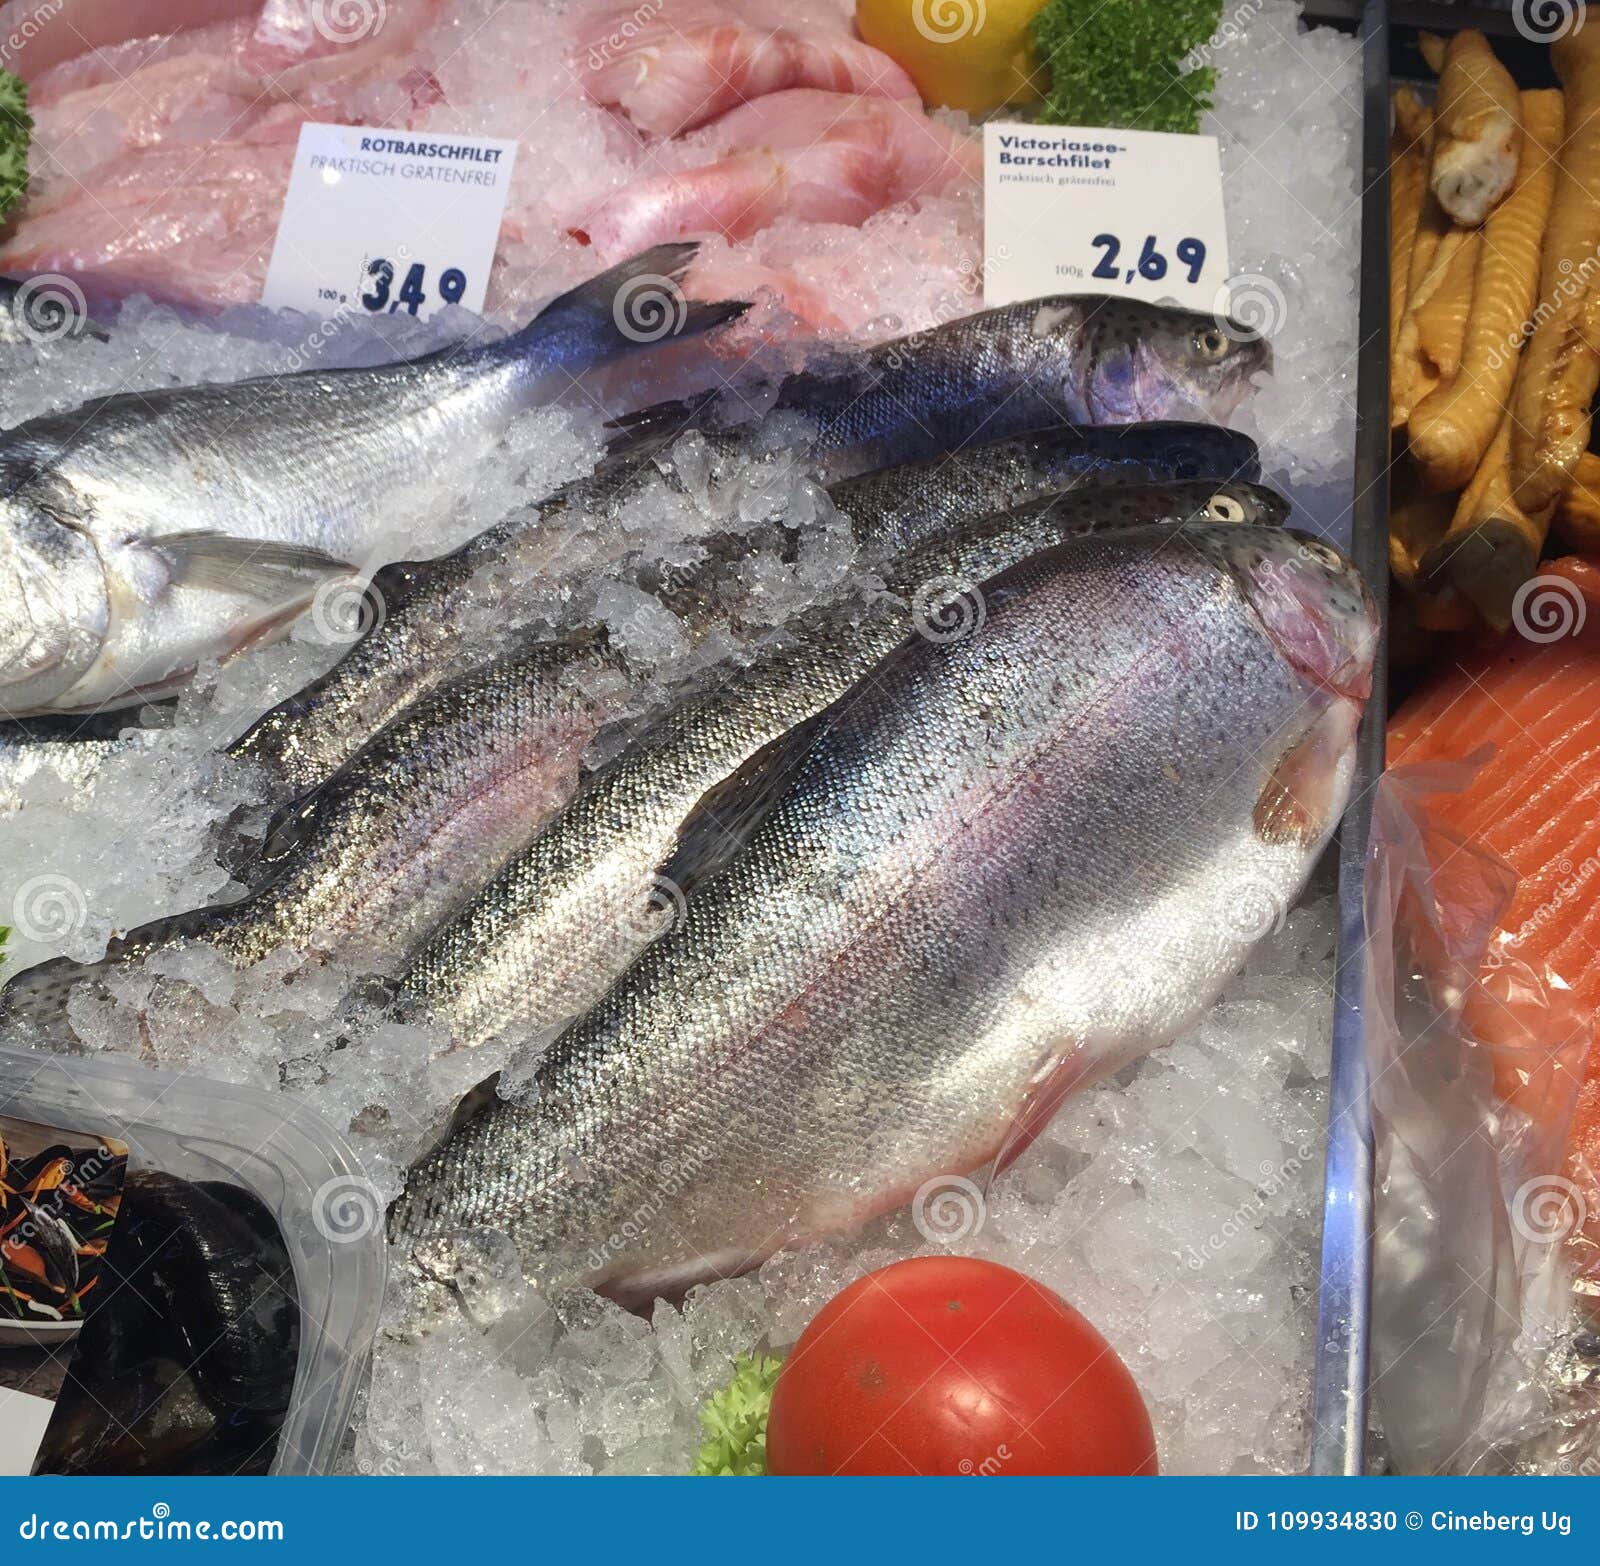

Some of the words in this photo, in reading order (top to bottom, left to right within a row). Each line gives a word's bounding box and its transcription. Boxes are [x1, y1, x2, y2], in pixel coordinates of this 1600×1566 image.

[360, 137, 502, 163] ROTBARSCHFILET
[999, 135, 1127, 153] Victoriasee-
[309, 154, 396, 177] PRAKTISCH
[999, 152, 1111, 169] Barschfilet
[1091, 233, 1207, 285] 2,69
[1055, 263, 1084, 279] 100g
